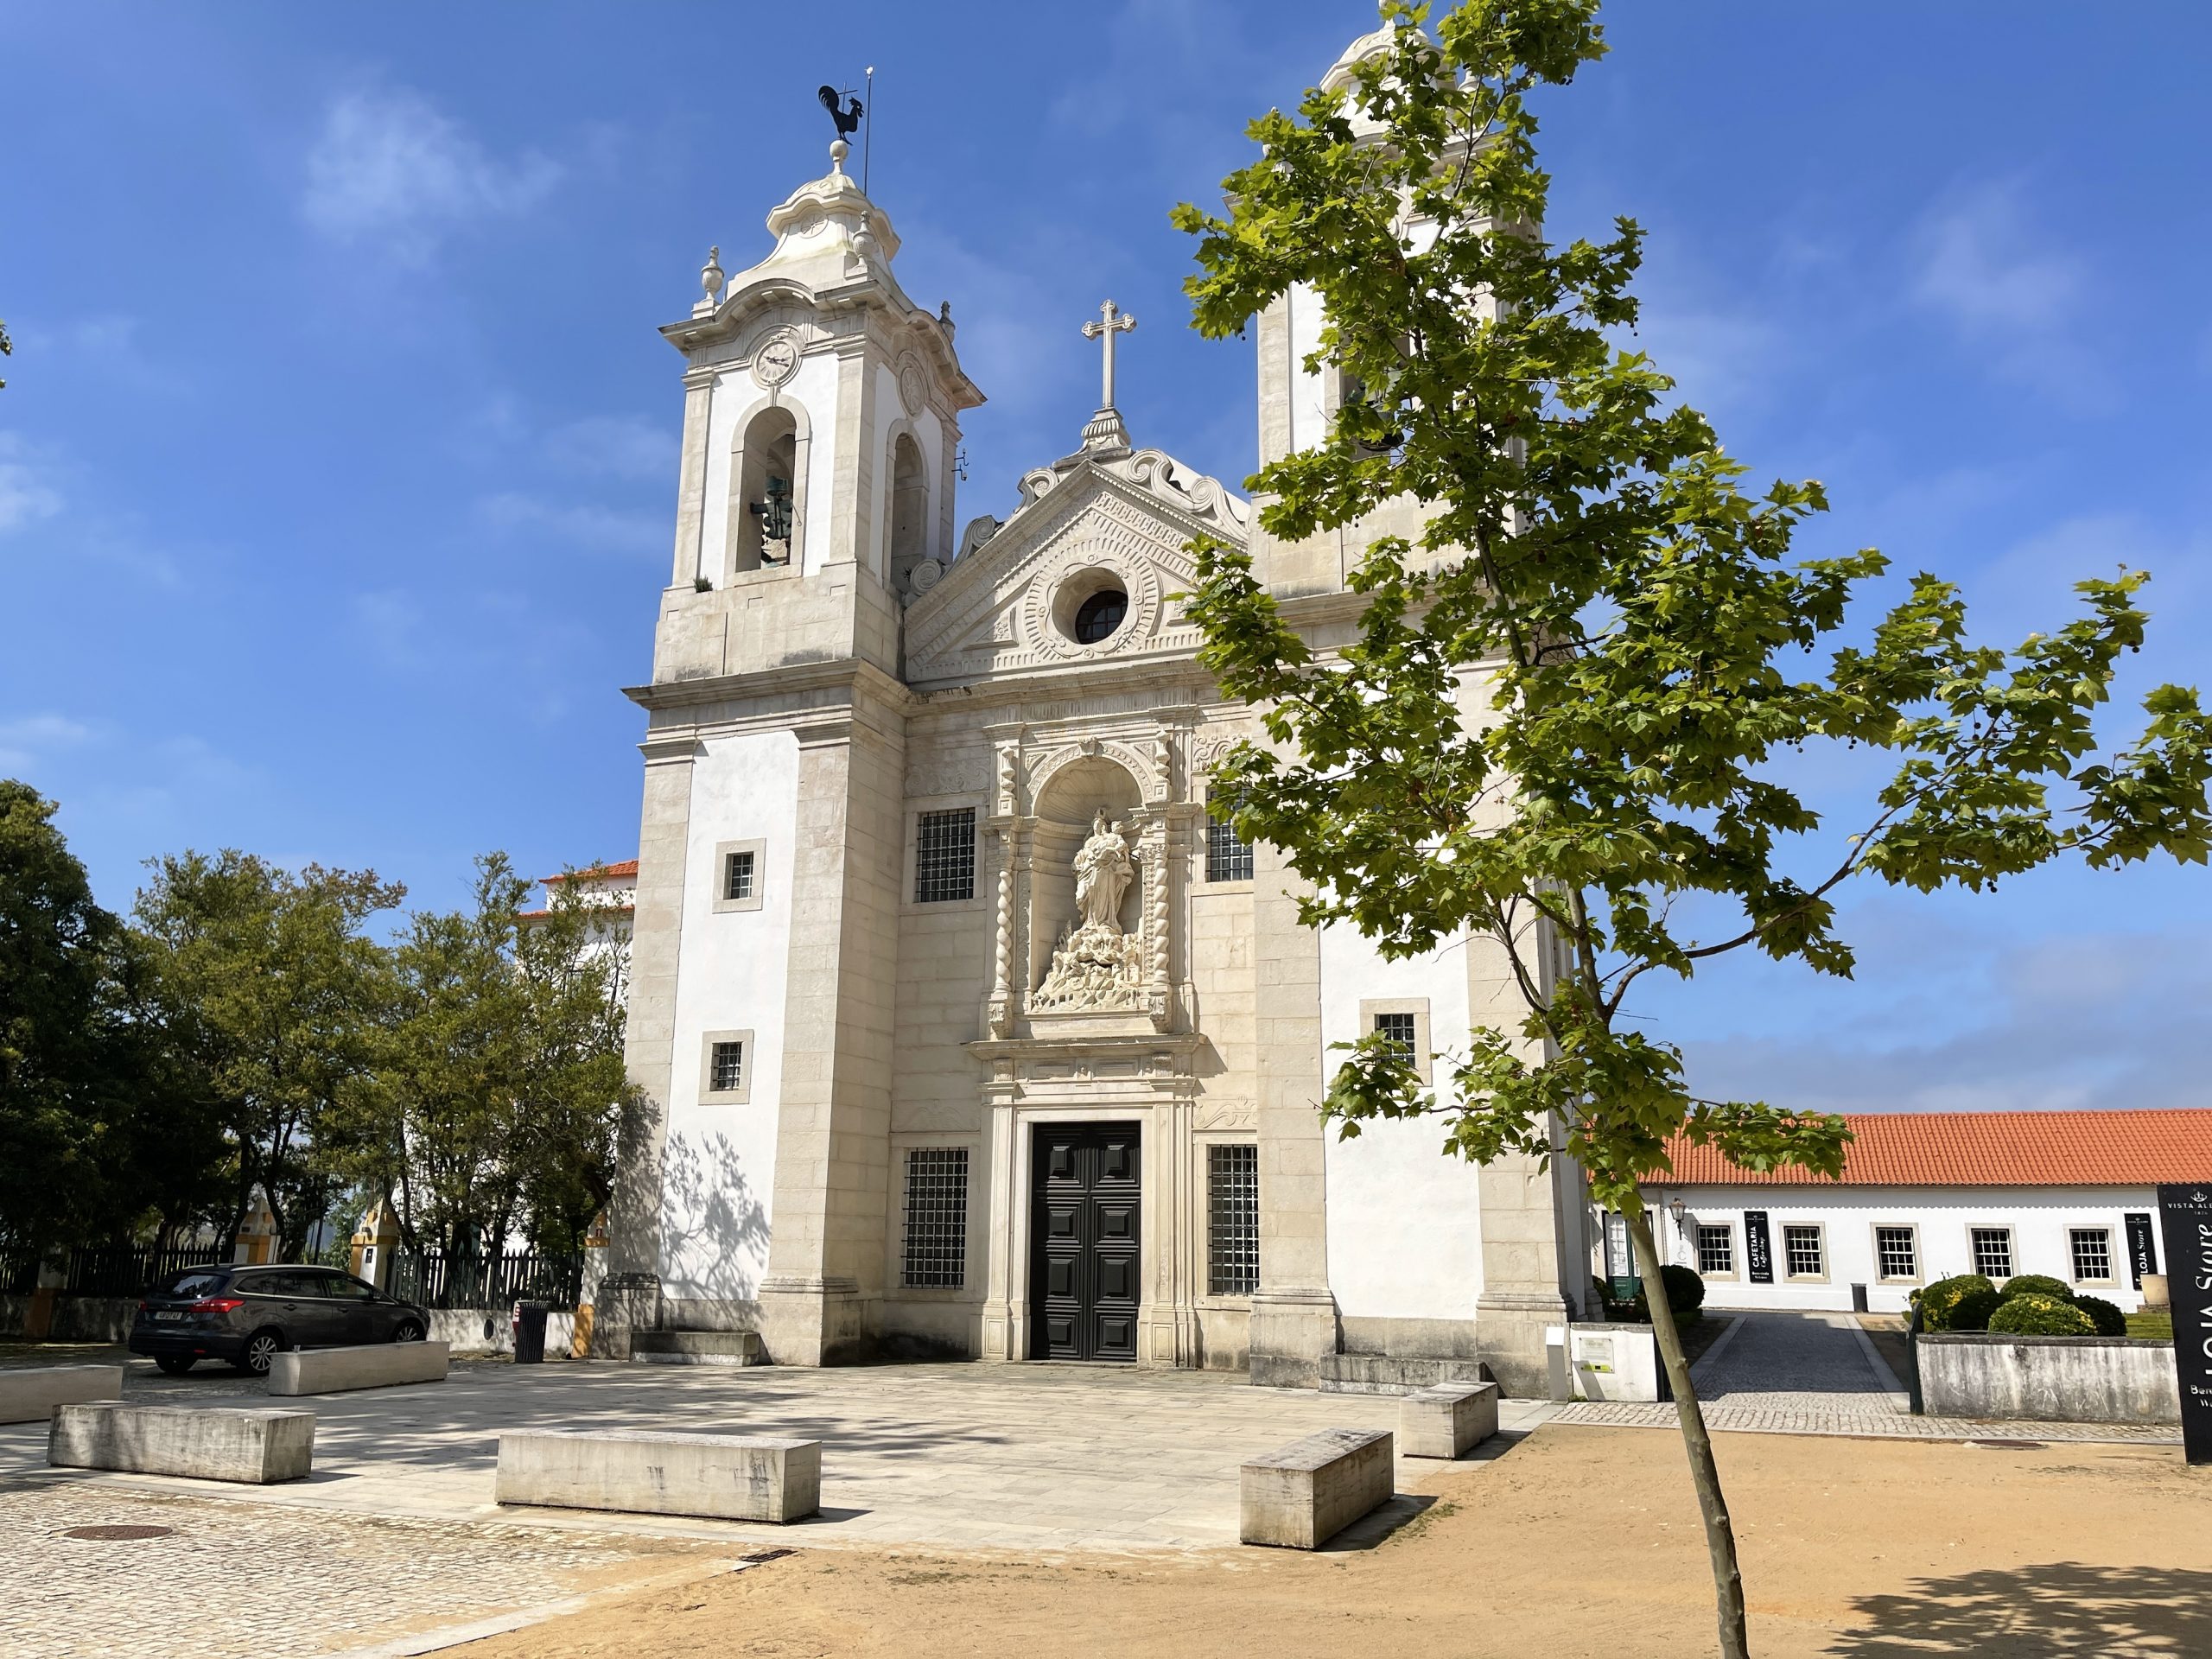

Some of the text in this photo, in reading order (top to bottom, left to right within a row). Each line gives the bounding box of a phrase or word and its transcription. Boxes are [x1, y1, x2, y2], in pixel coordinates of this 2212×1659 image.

[1750, 1226, 1760, 1268] CAFETARIA
[2137, 1229, 2145, 1250] Store
[2139, 1251, 2149, 1274] LOJA
